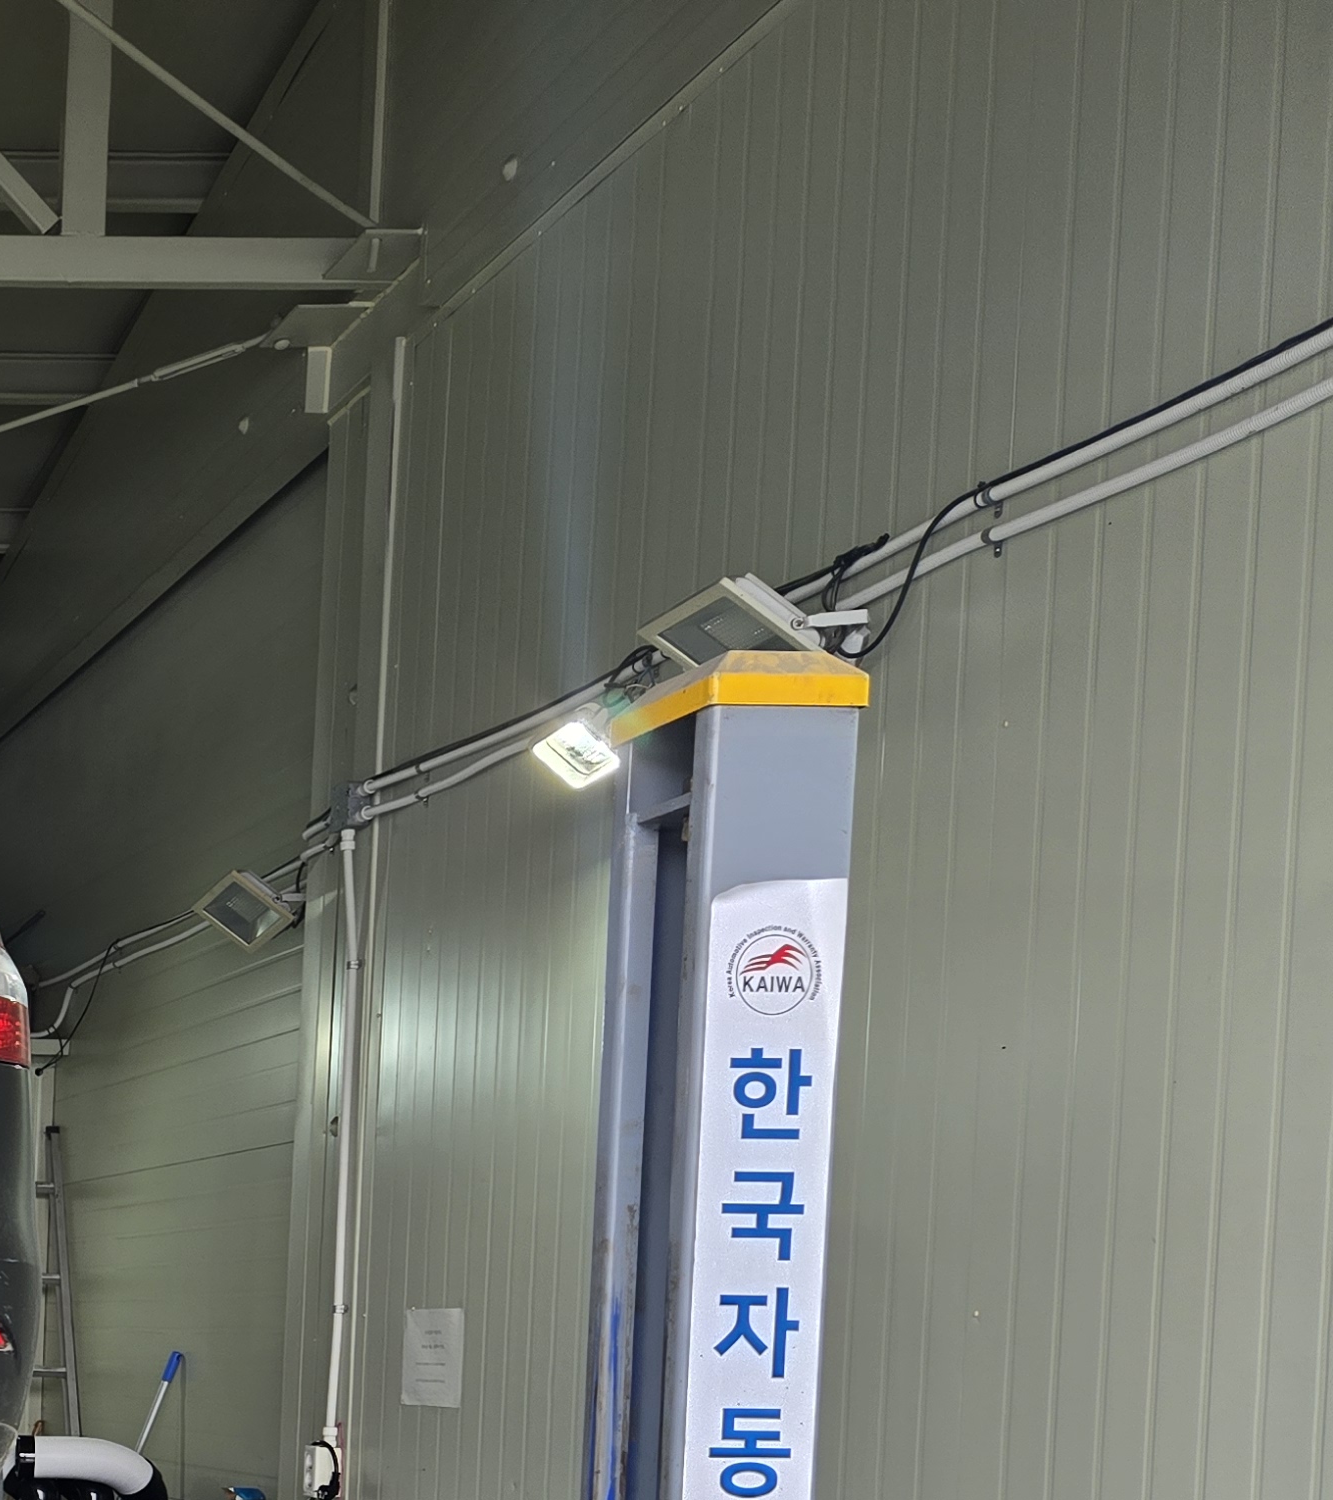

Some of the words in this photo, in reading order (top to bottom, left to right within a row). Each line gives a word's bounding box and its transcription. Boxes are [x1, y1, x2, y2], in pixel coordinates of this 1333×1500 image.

[726, 939, 748, 975] Automotive
[783, 926, 798, 935] and
[797, 931, 820, 958] Warranty
[742, 976, 806, 993] KAIWA
